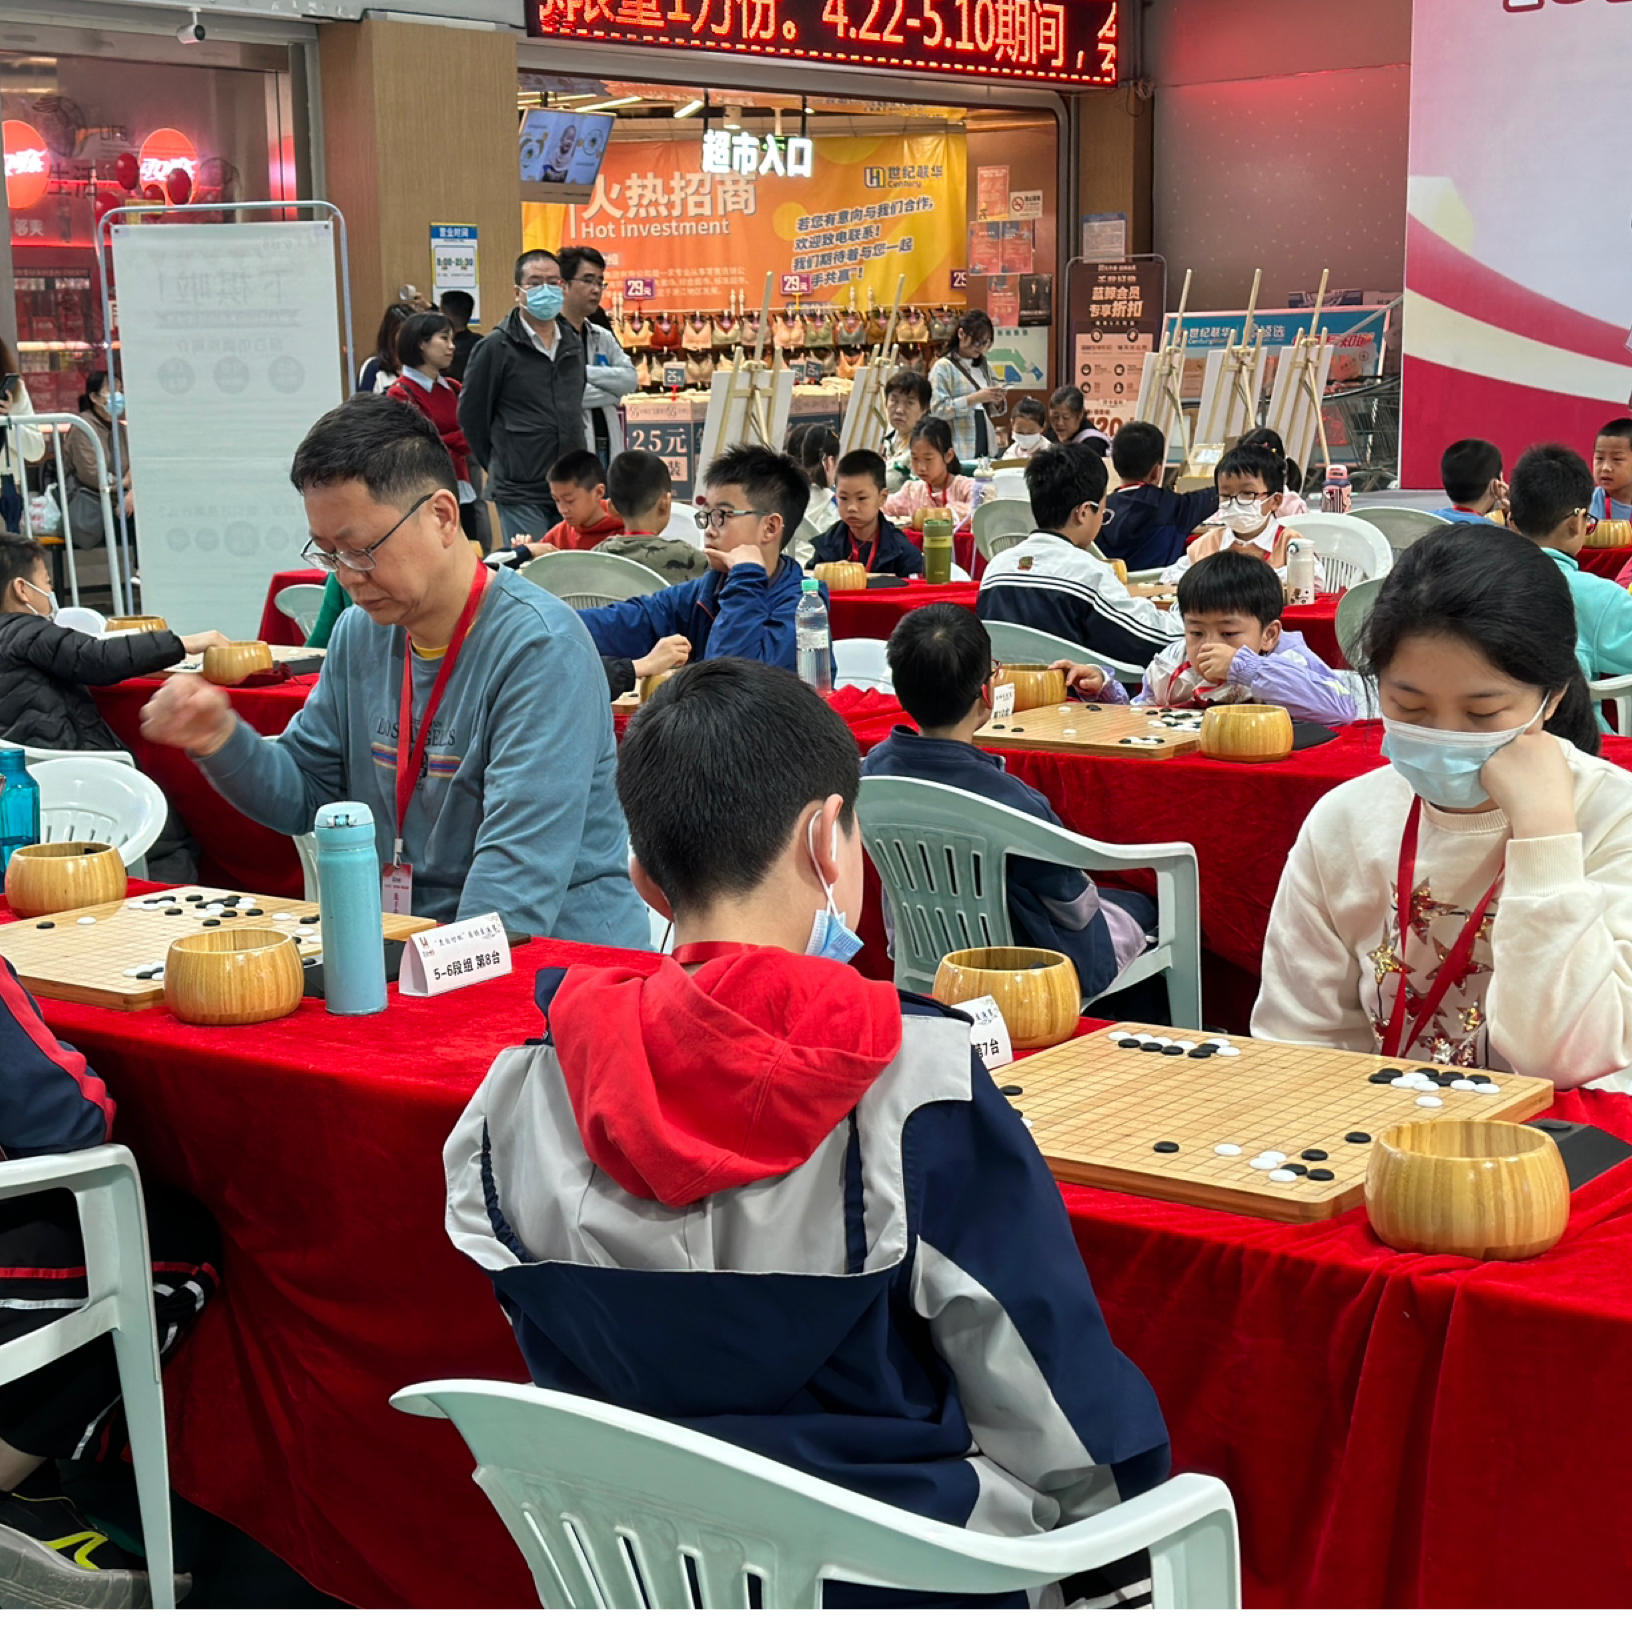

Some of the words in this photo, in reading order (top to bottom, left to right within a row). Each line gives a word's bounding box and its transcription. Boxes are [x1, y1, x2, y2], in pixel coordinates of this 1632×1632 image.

[702, 129, 813, 178] 超市入口
[581, 170, 758, 220] 火热招商
[581, 222, 617, 239] Hot
[620, 218, 731, 239] investment
[792, 237, 914, 271] 我们期待着与您一起
[631, 428, 688, 454] 25元
[433, 957, 474, 981] 5-6段组
[475, 949, 500, 971] 第8台
